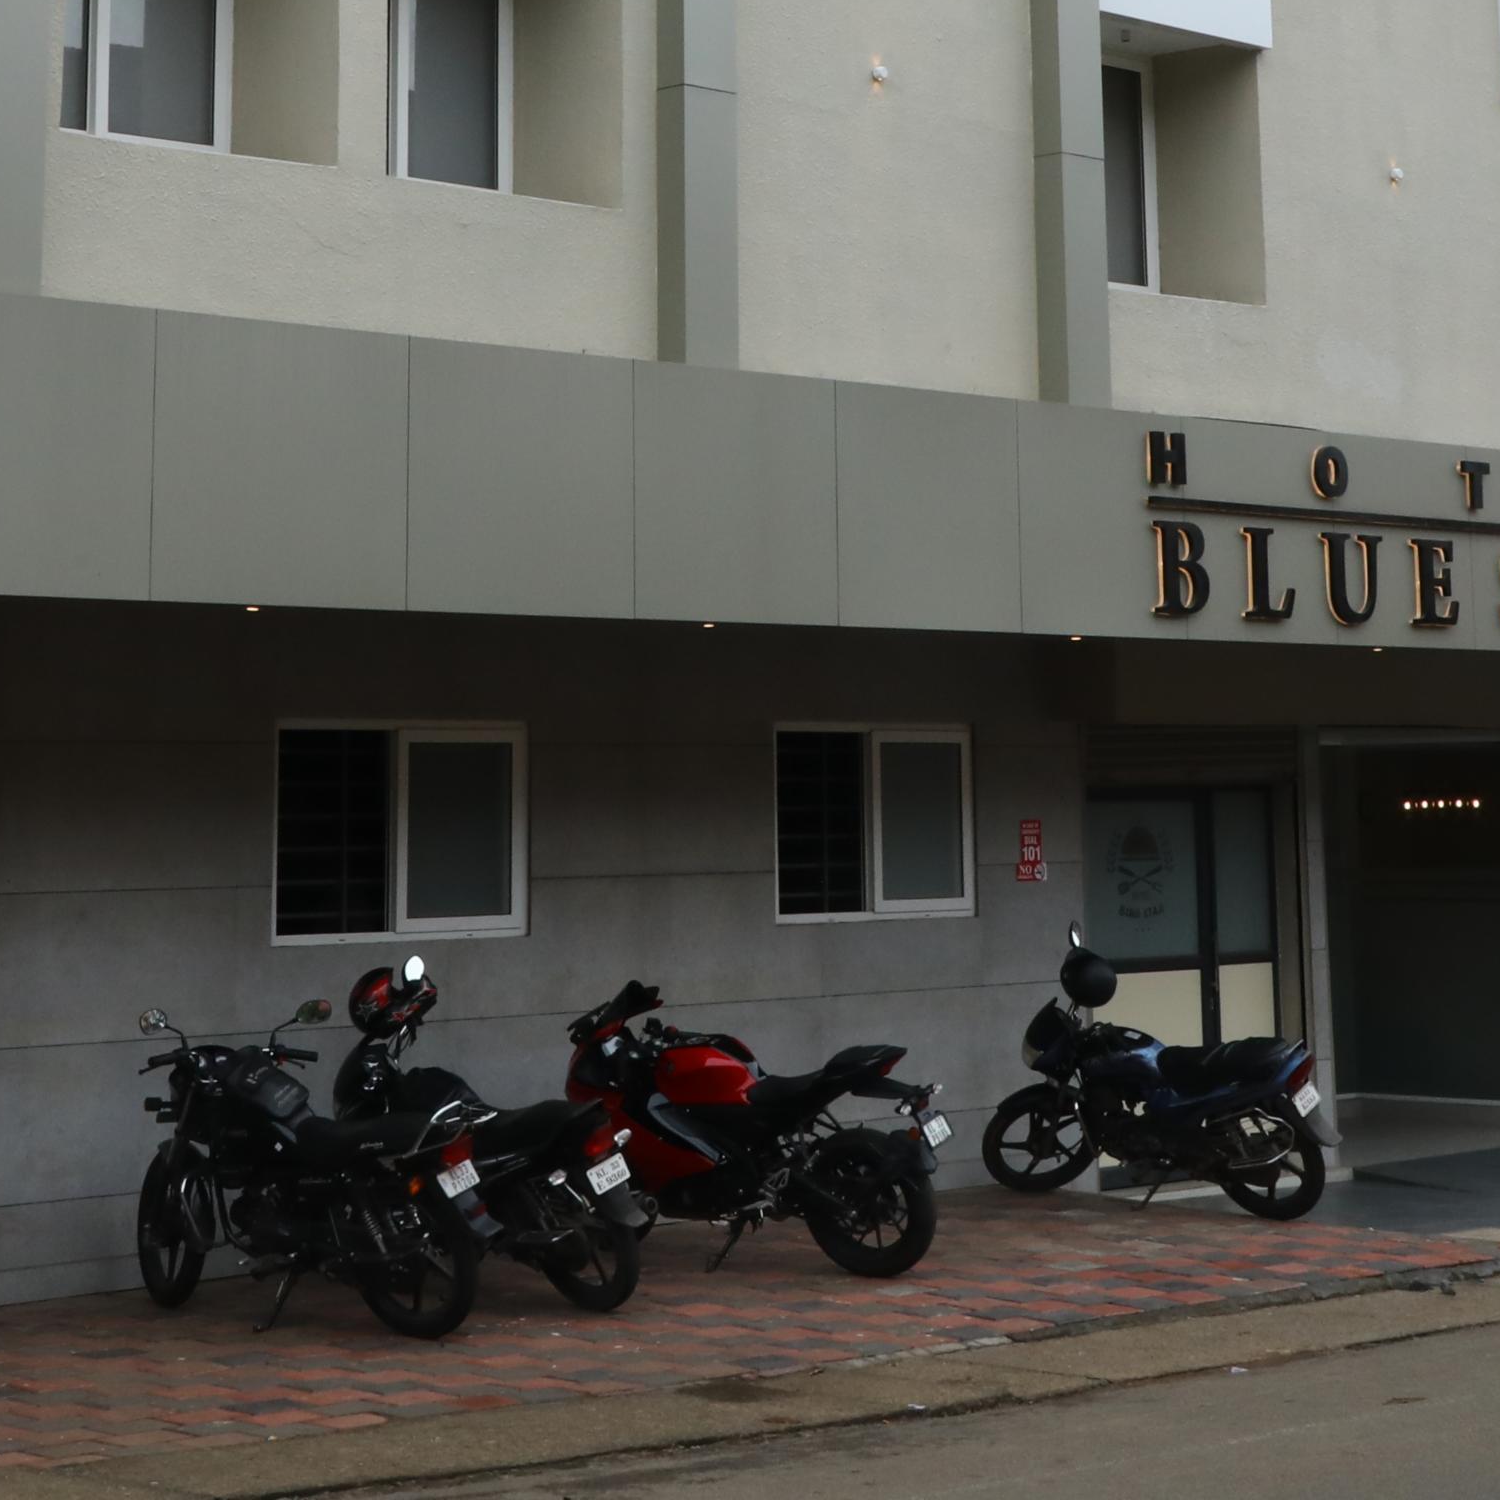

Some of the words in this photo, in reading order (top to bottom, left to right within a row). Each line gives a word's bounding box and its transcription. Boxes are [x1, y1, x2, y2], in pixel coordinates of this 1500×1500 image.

[1023, 835, 1038, 845] DIAL
[1021, 845, 1041, 861] 101
[1019, 865, 1033, 875] NO
